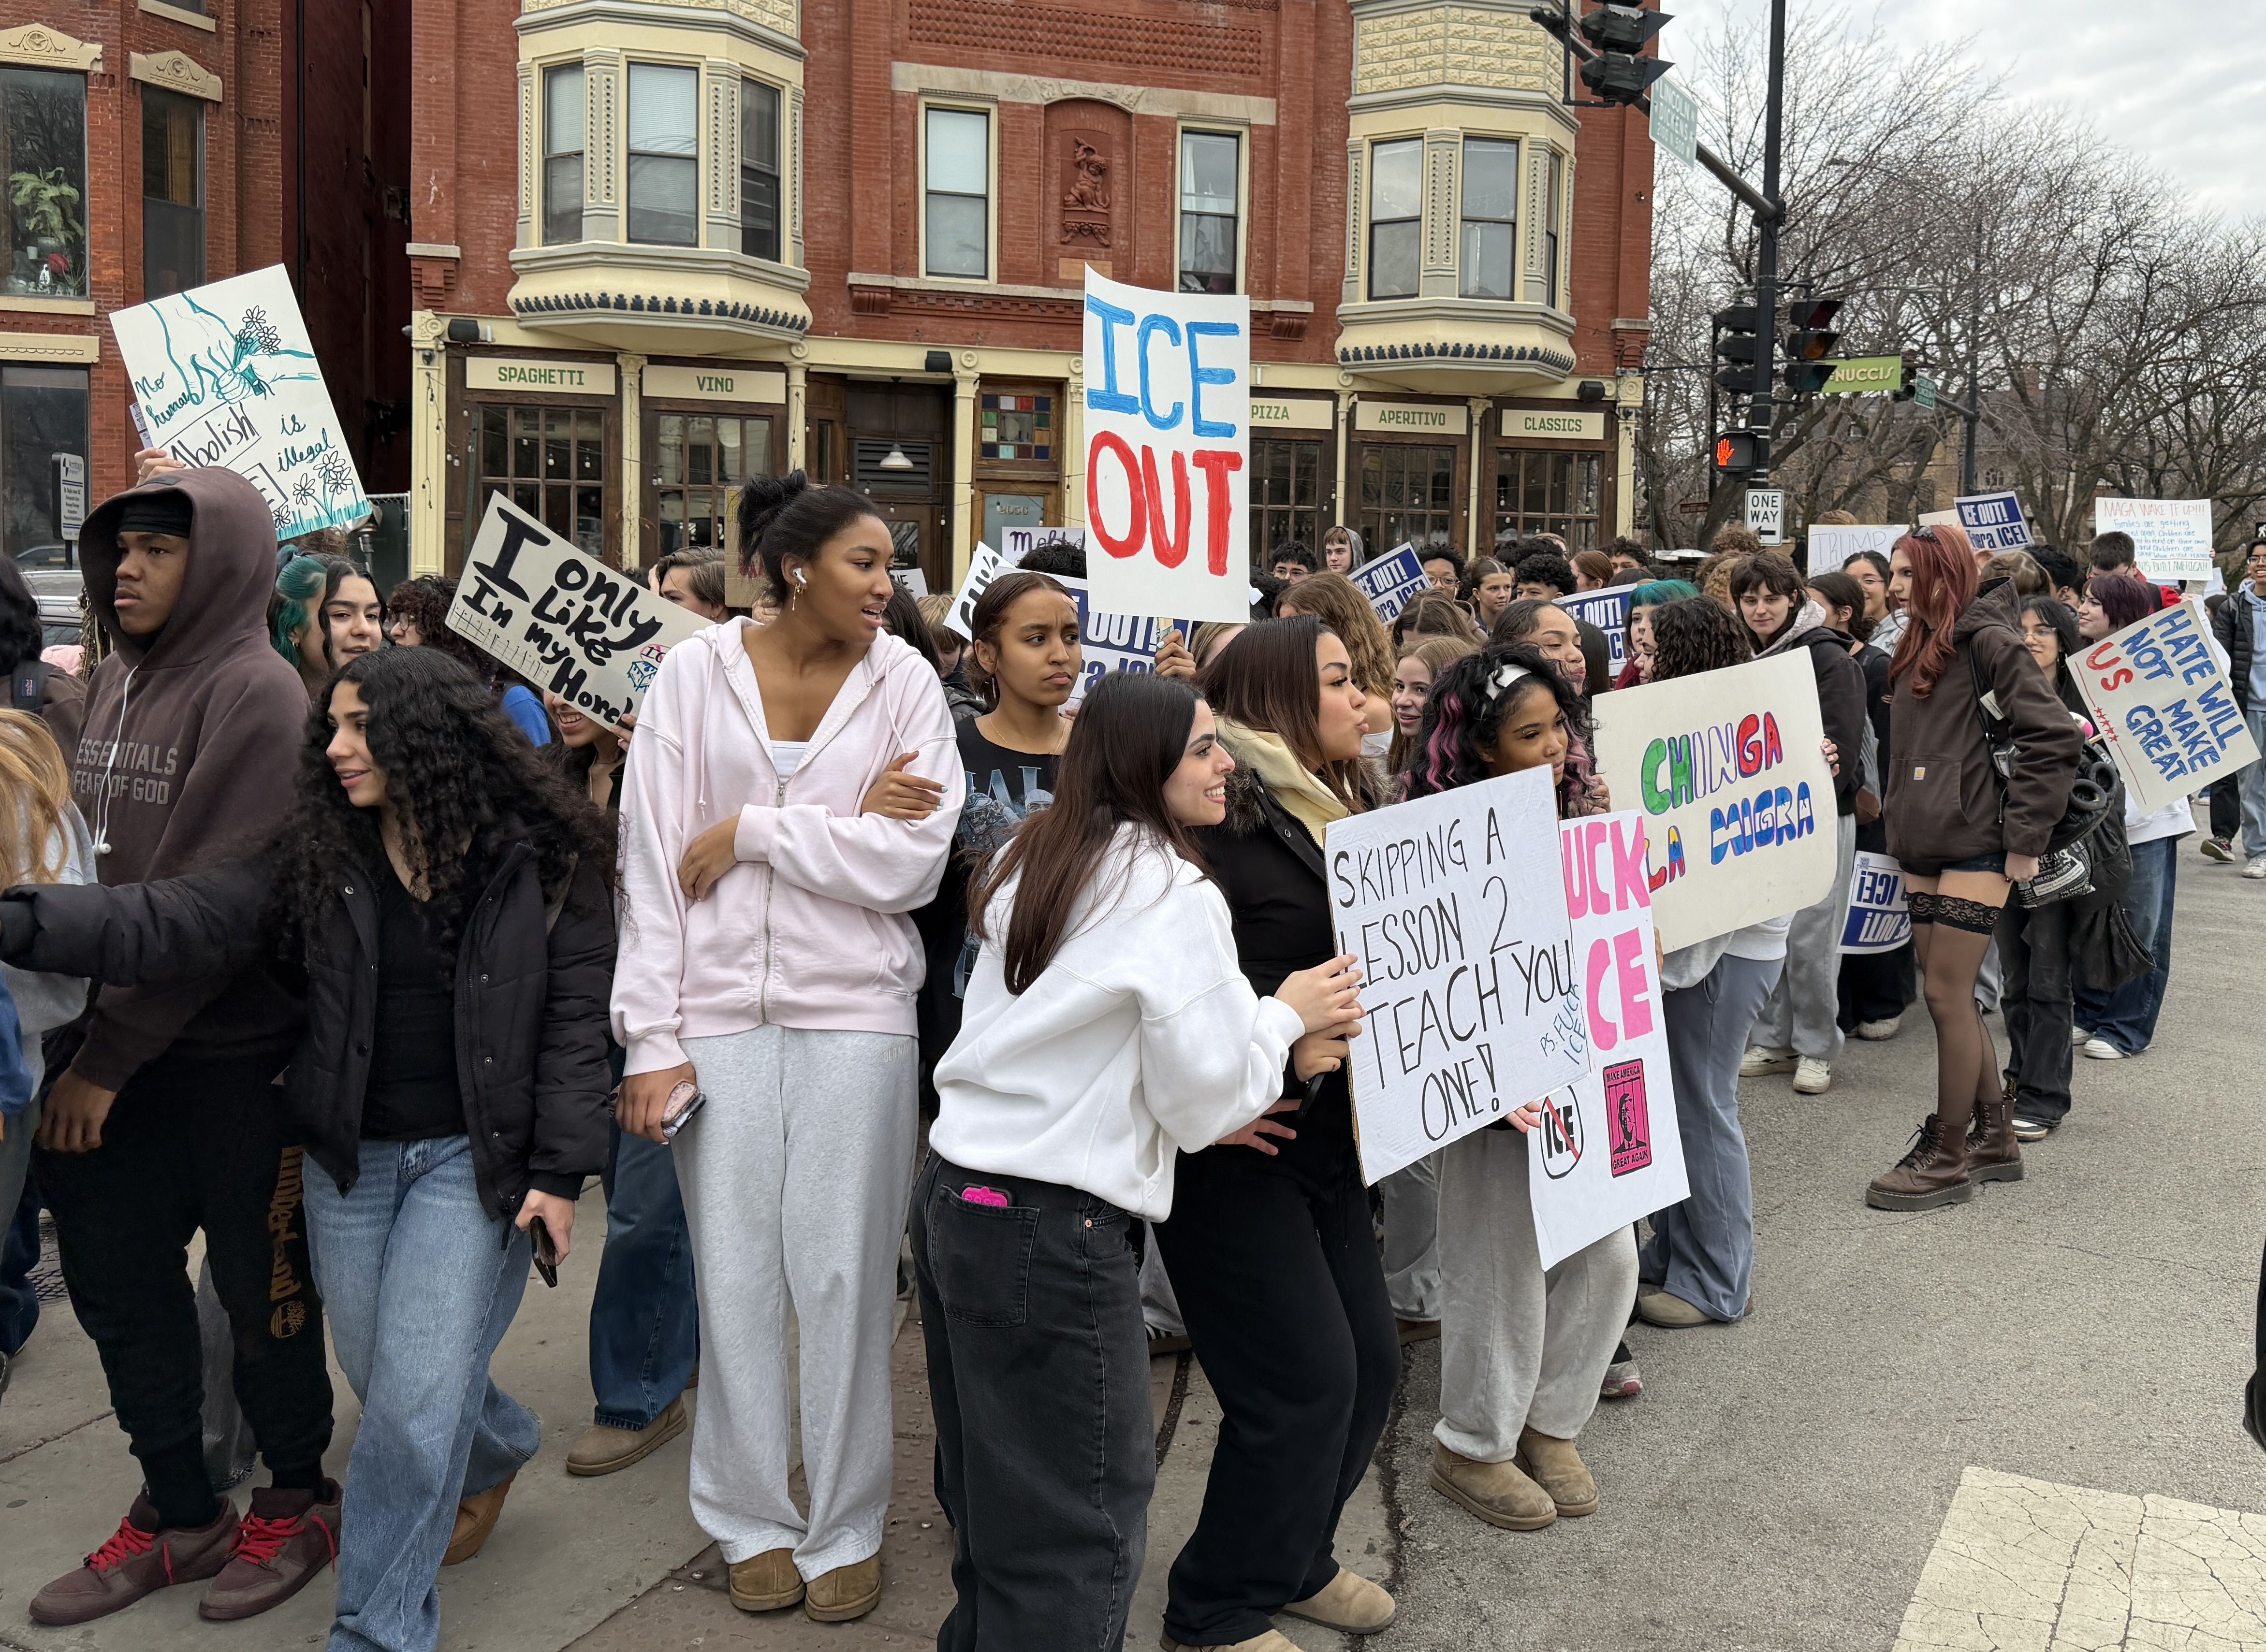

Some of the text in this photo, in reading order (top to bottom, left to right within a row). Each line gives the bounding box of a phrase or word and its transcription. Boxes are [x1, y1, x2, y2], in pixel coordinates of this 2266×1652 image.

[1659, 79, 1690, 121] LINCOLN
[498, 366, 584, 386] SPAGHETTI
[696, 376, 734, 392] VINO
[1087, 293, 1241, 438] ICE
[280, 414, 306, 436] is
[1251, 405, 1289, 420] PIZZA
[1379, 409, 1446, 426] APERITIVO
[1524, 417, 1582, 432] CLASSICS
[171, 406, 257, 468] Abolish
[277, 427, 336, 472] illegal
[1087, 431, 1243, 577] OUT
[1750, 510, 1779, 523] WAY
[1751, 494, 1779, 508] ONE
[1961, 501, 2009, 526] ICE OUT!
[2104, 501, 2205, 518] MAGA WAKE TF UP!!!
[1996, 524, 2028, 547] ICE!
[2160, 520, 2190, 530] getting
[1811, 531, 1886, 566] TRUMP
[472, 506, 663, 651] I only
[1371, 558, 1408, 593] OUT!
[462, 575, 513, 629] In
[524, 622, 570, 665] my
[531, 585, 613, 666] Like
[1584, 597, 1623, 628] OUT!
[2154, 609, 2216, 686] HATE
[2196, 681, 2245, 751] WILL
[2086, 641, 2189, 782] US GREAT
[2120, 627, 2174, 680] NOT
[2161, 698, 2221, 773] MAKE
[76, 738, 178, 775] ESSENTIALS
[1641, 711, 1783, 816] CHINGA
[73, 770, 170, 805] FEAR OF GOD
[1644, 781, 1814, 894] LA MIGRA
[1334, 807, 1506, 909] SKIPPING A
[1562, 816, 1651, 920] UCK
[1856, 870, 1899, 906] ICE!
[1340, 876, 1523, 990] LESSON 2
[1858, 912, 1902, 942] OUT!
[1586, 927, 1653, 1051] CE
[1366, 939, 1572, 1089] TEACH YOU
[1564, 1017, 1586, 1065] ICE
[1421, 1043, 1499, 1142] ONE!
[1606, 1065, 1640, 1083] MAKE AMERICA
[1544, 1105, 1575, 1159] ICE
[1613, 1150, 1649, 1170] GREAT AGAIN
